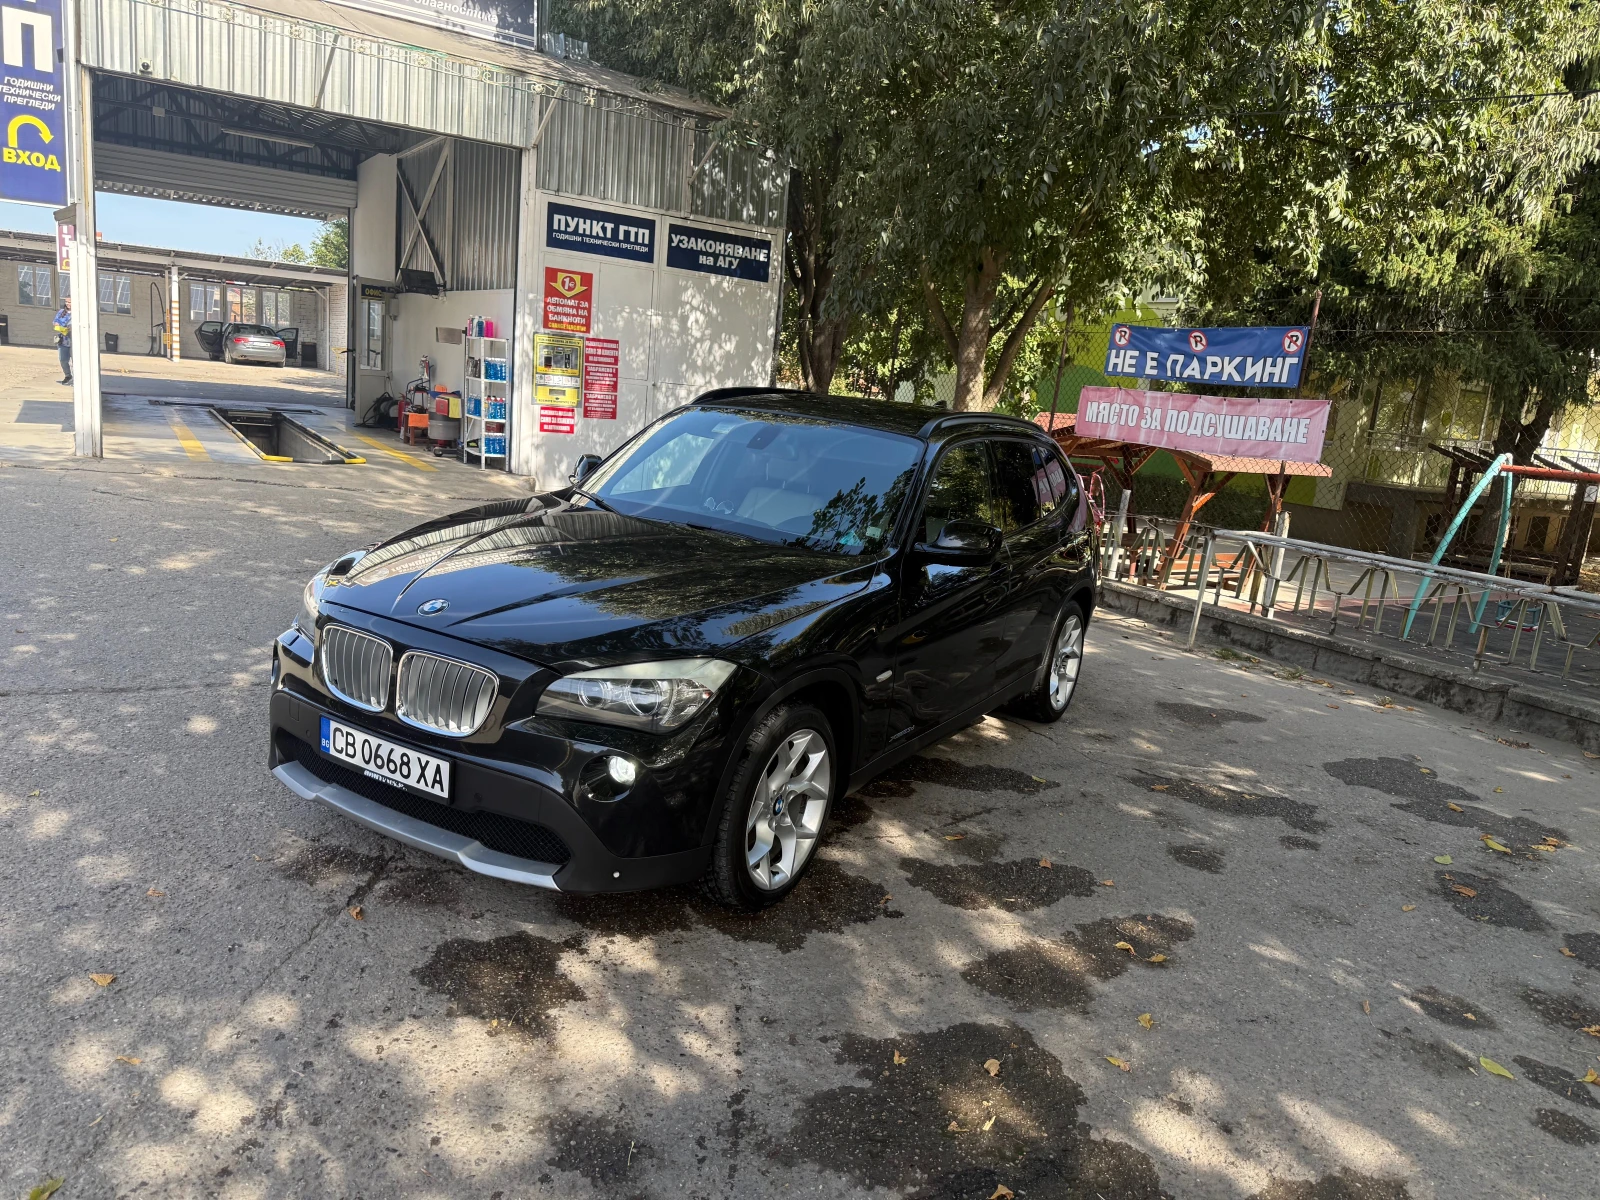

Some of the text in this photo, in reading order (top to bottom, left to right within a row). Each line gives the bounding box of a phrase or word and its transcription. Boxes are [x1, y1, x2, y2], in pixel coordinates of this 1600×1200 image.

[0, 84, 61, 103] ТЕХНИЧЕСКИ
[4, 76, 54, 92] ГОДИШНИ
[4, 94, 56, 111] ПРЕГЛЕДИ
[2, 147, 61, 172] ВХОД
[553, 213, 650, 245] ПУНКТ ГТП
[552, 232, 649, 253] ГОДИШНИ ТЕХНИЧЕСКИ ПРЕГЛЕДИ
[671, 233, 769, 262] УЗАКОНЯВАНЕ
[698, 255, 740, 269] на АГУ
[546, 305, 577, 315] ОБМЯНА
[547, 296, 589, 308] АВТОМАТ ЗА
[548, 314, 586, 324] БАНКНОТИ
[1107, 349, 1300, 383] НЕ Е ПАРКИНГ
[1085, 401, 1311, 444] МЯСТО ЗА ПОДСУШАВАНЕ
[321, 737, 330, 748] BG
[332, 726, 357, 759] CB
[361, 738, 412, 780] 0668
[416, 756, 445, 793] XA
